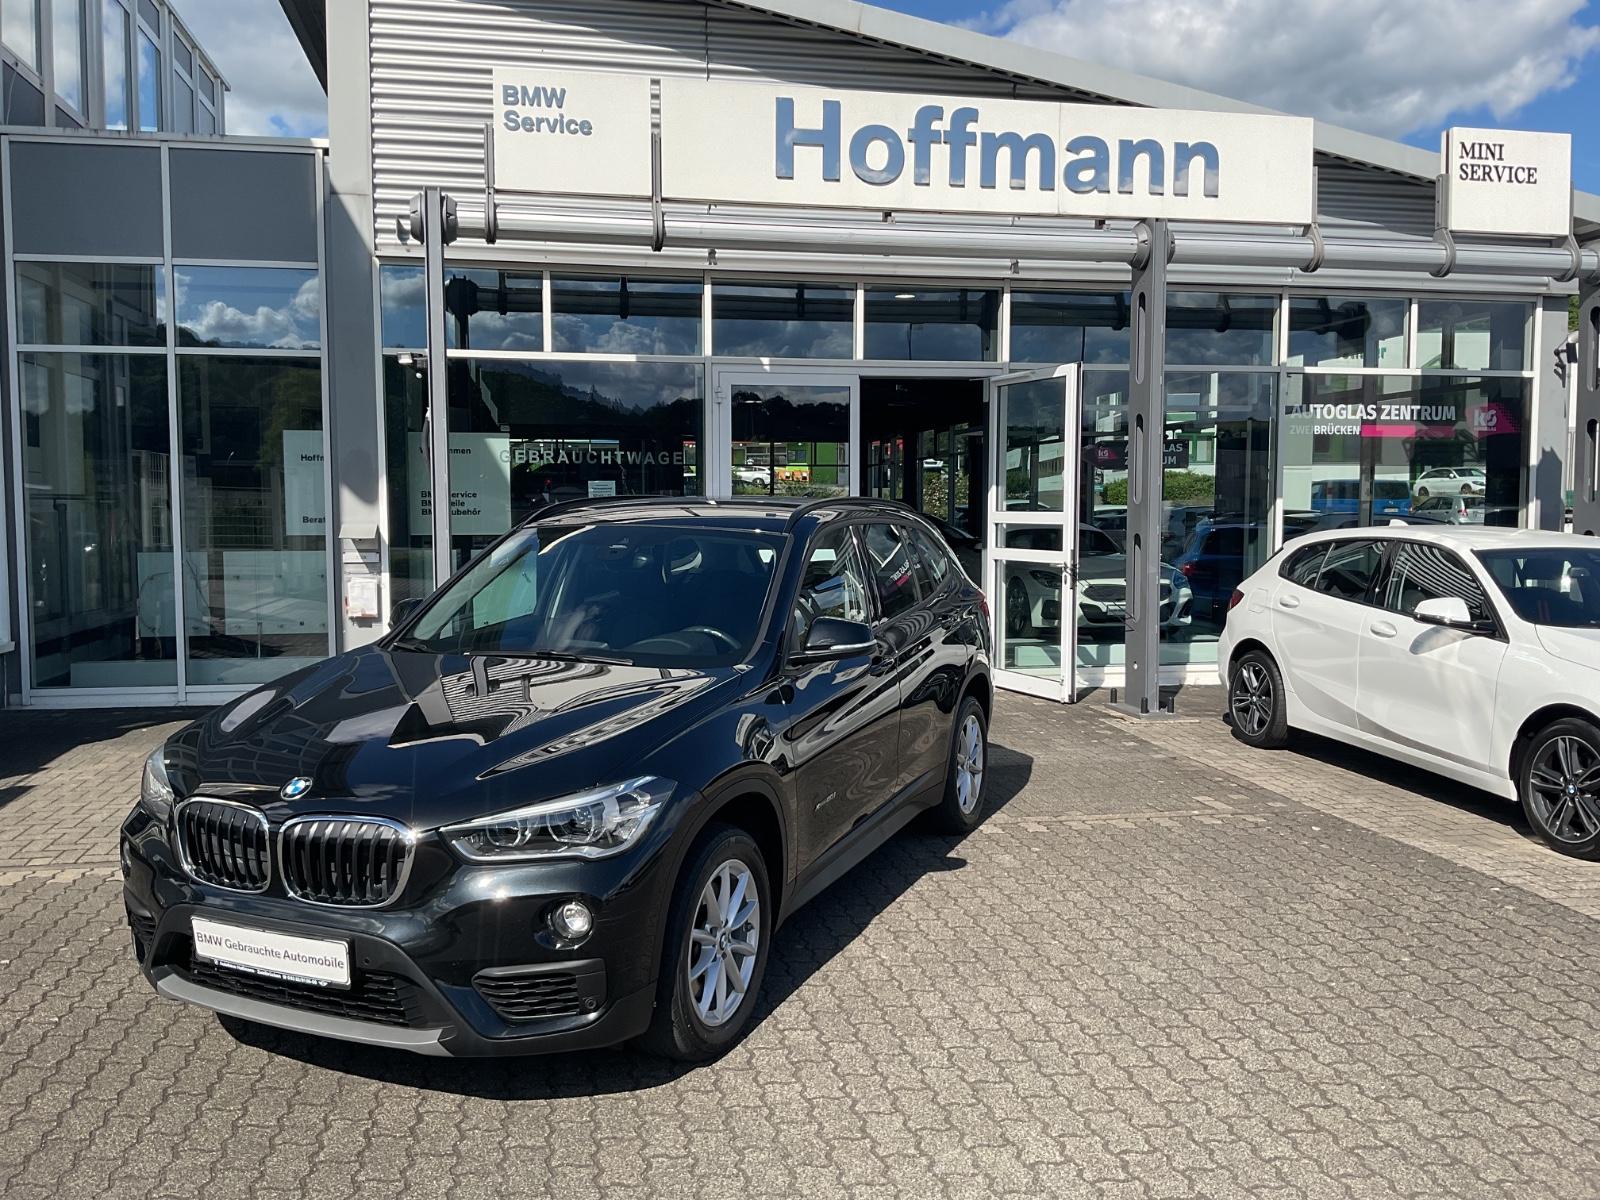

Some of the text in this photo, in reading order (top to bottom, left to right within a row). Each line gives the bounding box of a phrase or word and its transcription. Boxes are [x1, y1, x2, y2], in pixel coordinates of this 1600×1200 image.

[502, 84, 567, 109] BMW
[503, 110, 593, 136] Service
[775, 96, 1220, 198] Hoffmann
[1459, 141, 1505, 161] MINI
[1459, 163, 1538, 184] SERVICE
[1290, 403, 1456, 421] AUTOGLAS ZENTRUM
[1289, 423, 1360, 435] ZWEIBRÜCKEN
[196, 932, 345, 969] BMW Gebrauchte Automobile
